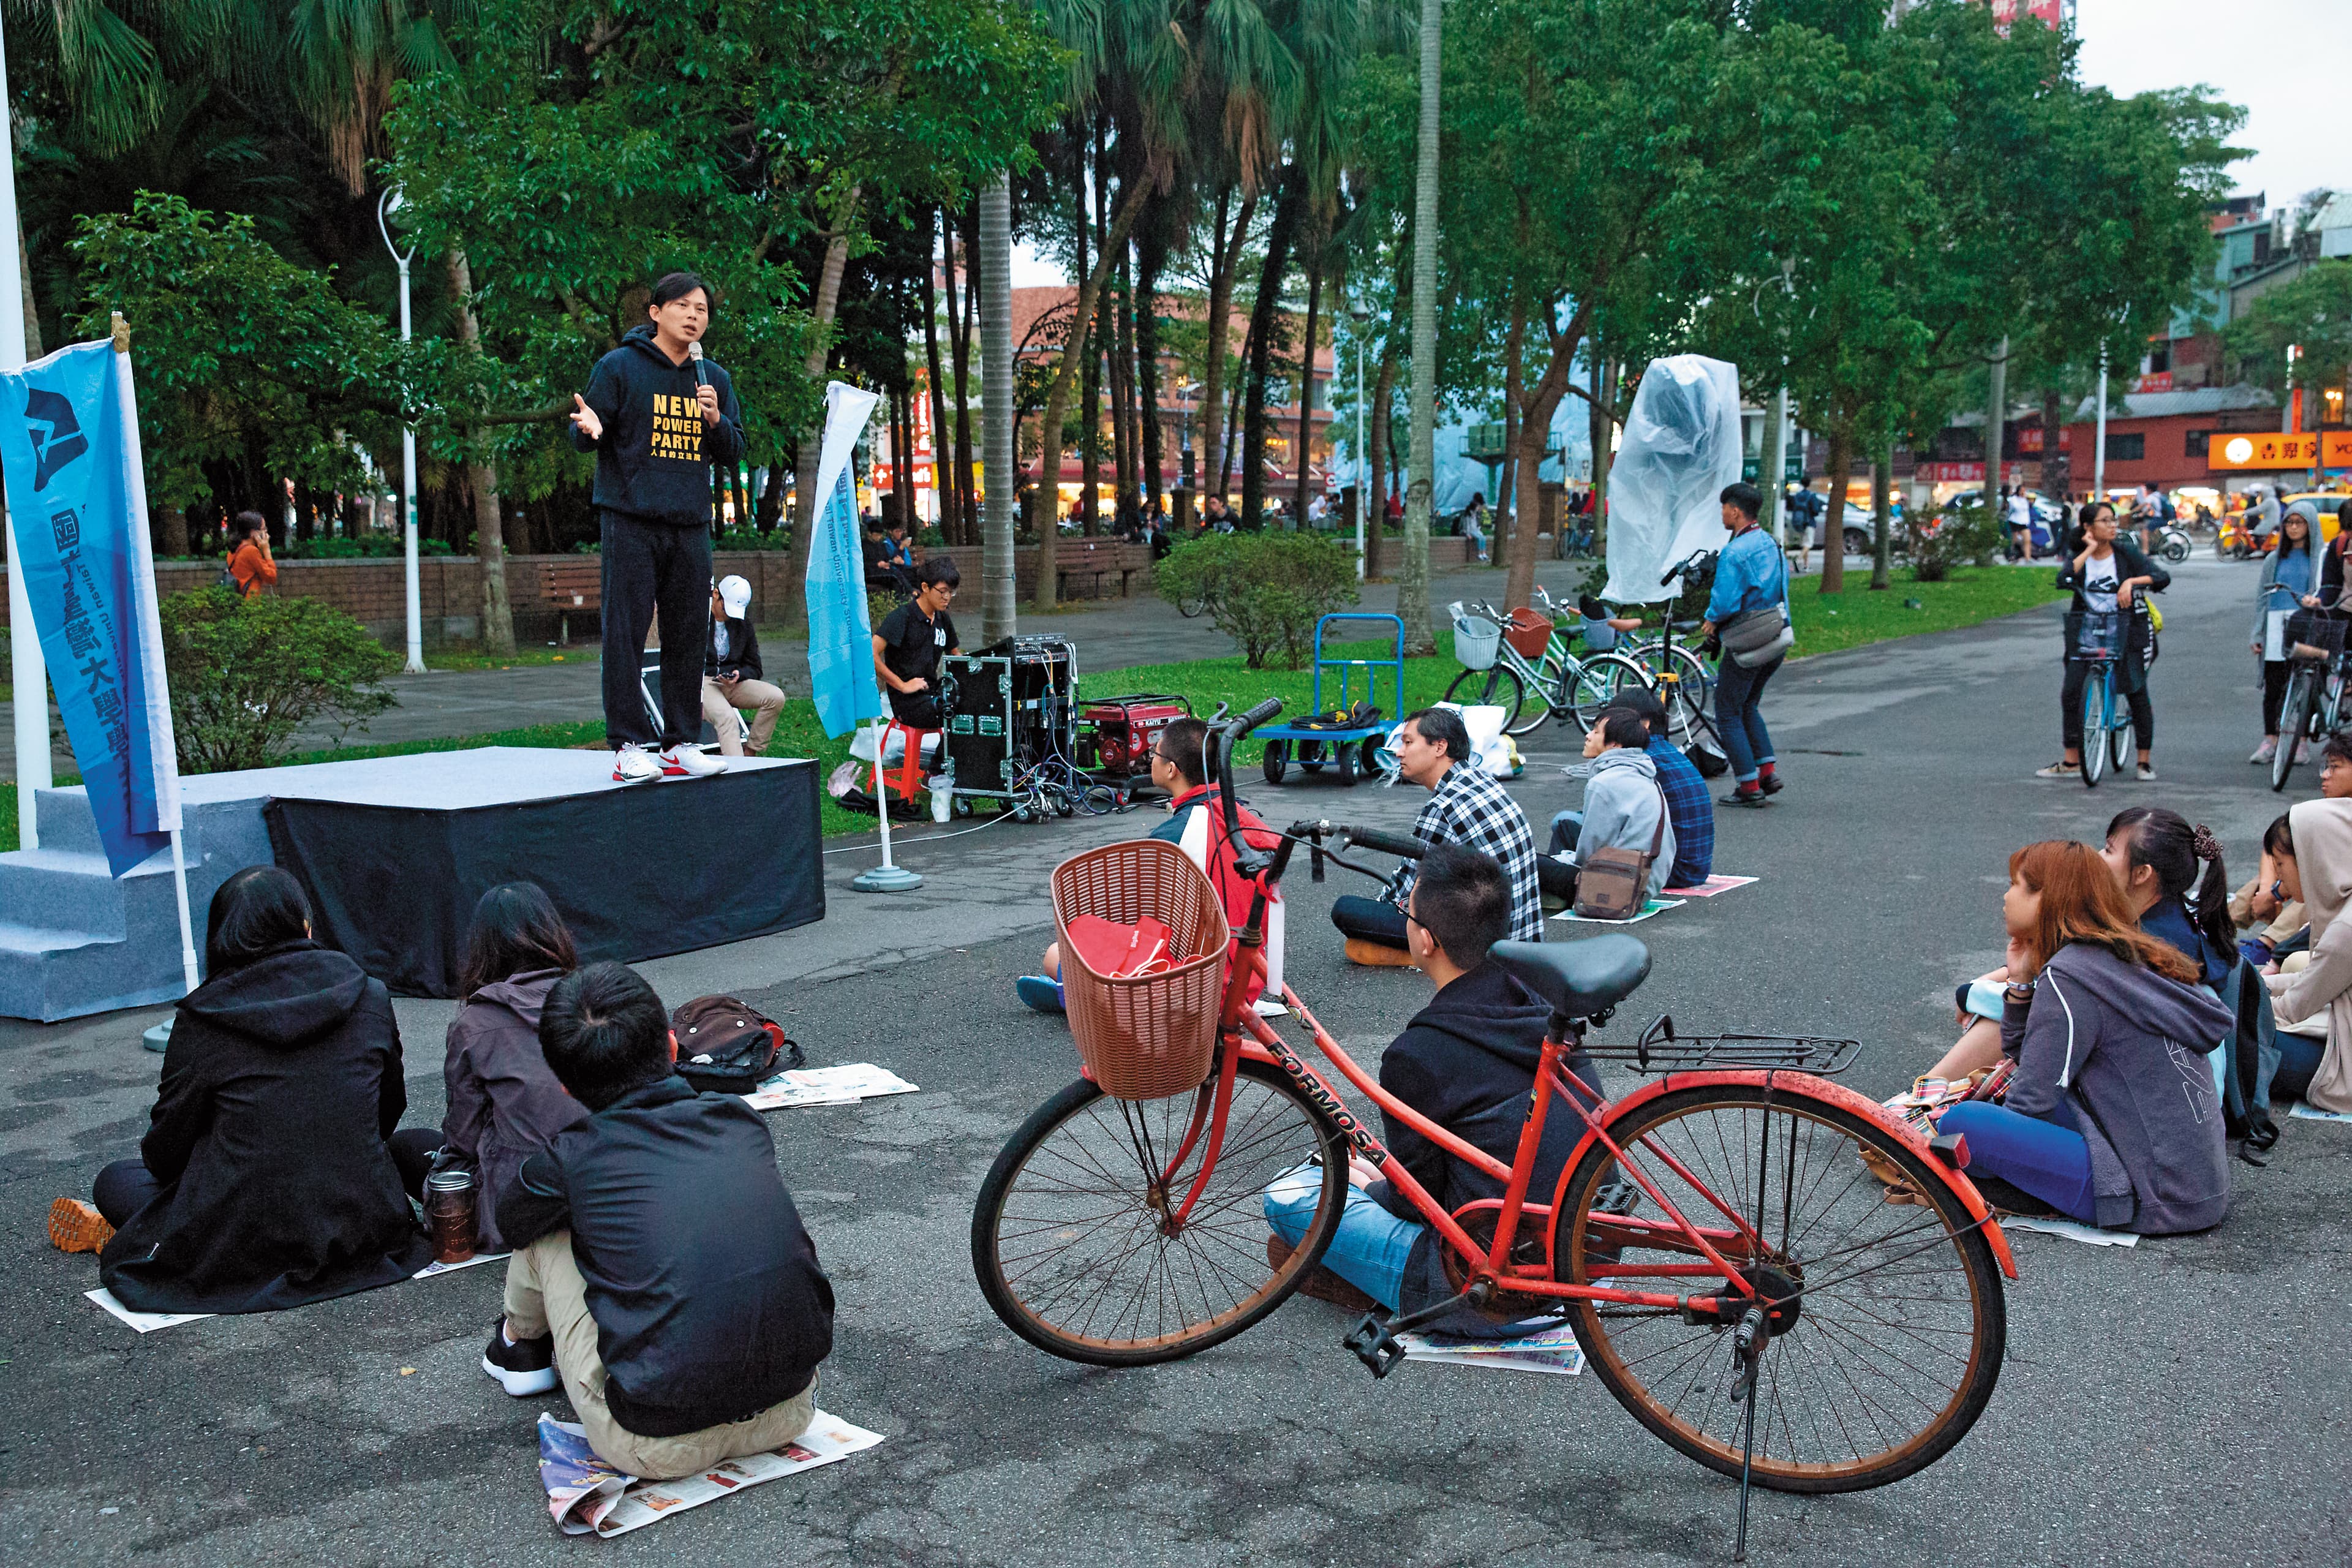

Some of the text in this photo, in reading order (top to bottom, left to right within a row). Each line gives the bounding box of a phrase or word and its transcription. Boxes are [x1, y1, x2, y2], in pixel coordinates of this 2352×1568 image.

[654, 393, 702, 418] NEW
[653, 416, 702, 434] POWER
[651, 432, 702, 451] PARTY
[650, 448, 701, 462] 人民的立法院
[827, 517, 839, 552] Taiwan
[833, 554, 848, 606] University
[1266, 1041, 1388, 1168] FORMOSA
